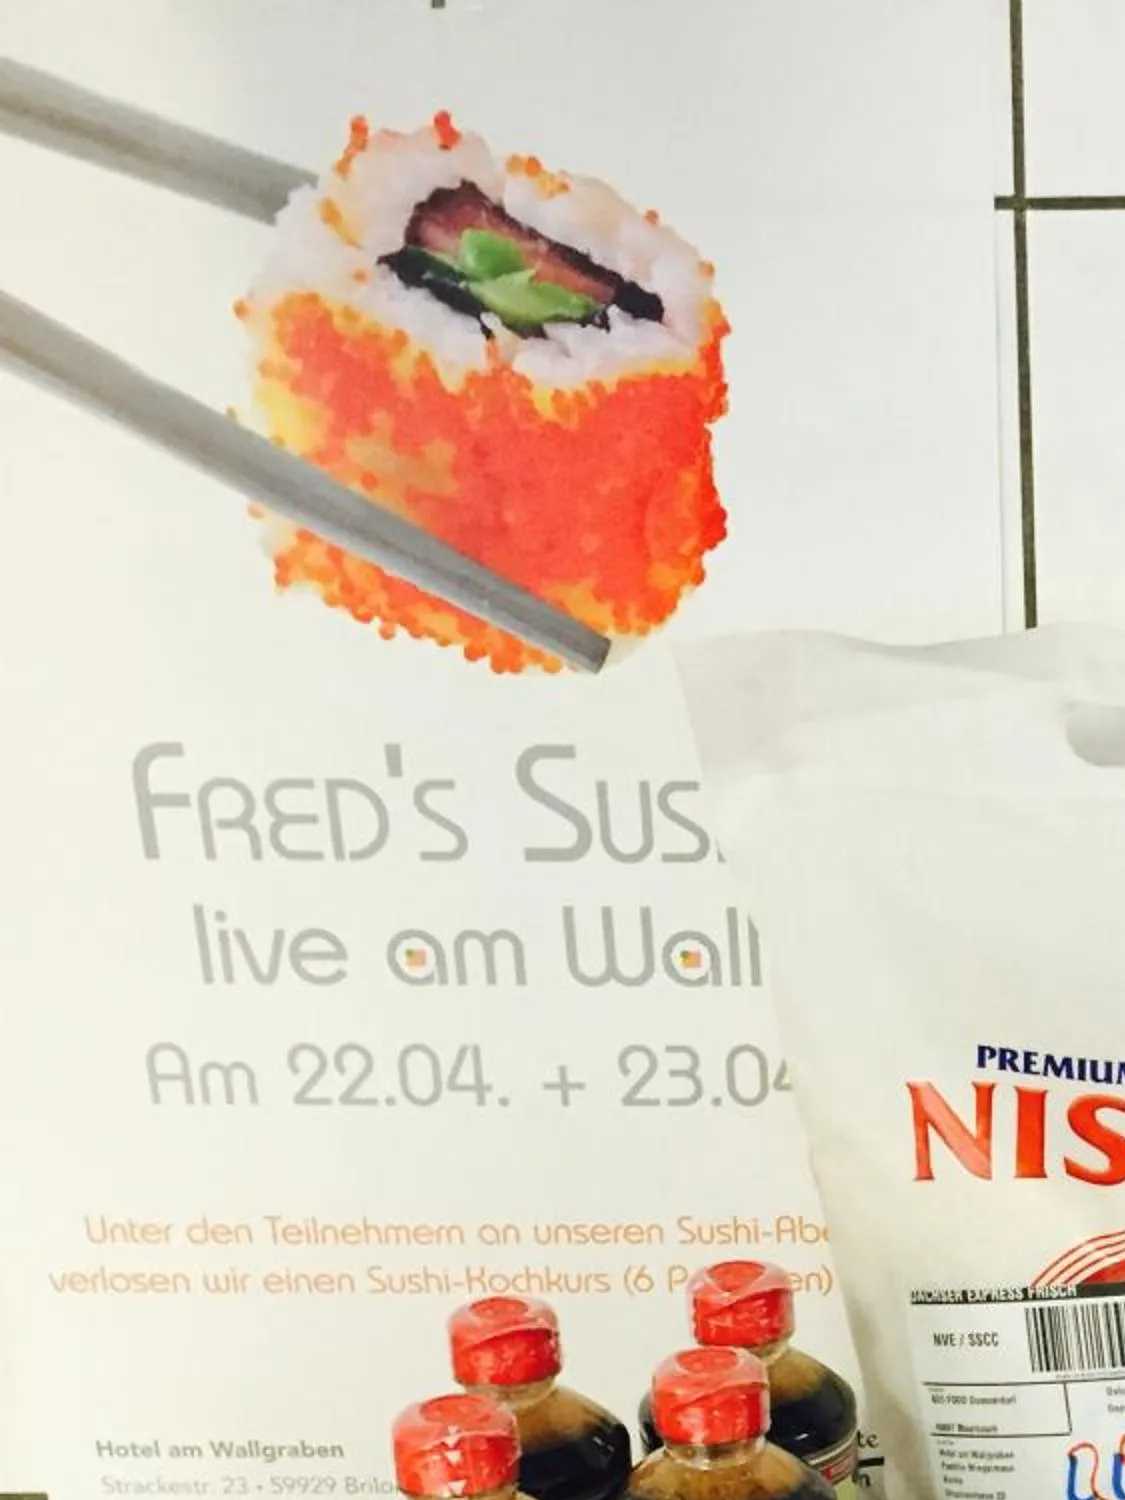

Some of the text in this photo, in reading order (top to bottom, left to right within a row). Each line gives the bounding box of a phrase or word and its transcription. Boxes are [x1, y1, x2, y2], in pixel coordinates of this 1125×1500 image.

[132, 742, 727, 865] FRED'S SUS
[193, 903, 763, 988] live am Wall
[146, 1042, 260, 1107] Am
[287, 1042, 511, 1108] 22.04.
[84, 1215, 173, 1246] Unter
[186, 1215, 254, 1246] den
[263, 1214, 466, 1247] Teilnehmern
[477, 1220, 520, 1246] an
[534, 1219, 664, 1247] unseren
[47, 1265, 192, 1295] verlosen
[203, 1266, 251, 1295] wir
[263, 1268, 356, 1295] einen
[366, 1264, 612, 1295] Sushi-Kochkurs
[933, 1332, 956, 1347] NVE
[967, 1331, 1000, 1348] SSCC
[96, 1439, 345, 1464] Hotel am Wallgraben
[222, 1476, 250, 1496] 23
[269, 1475, 338, 1496] 59929
[345, 1474, 398, 1496] Brilo
